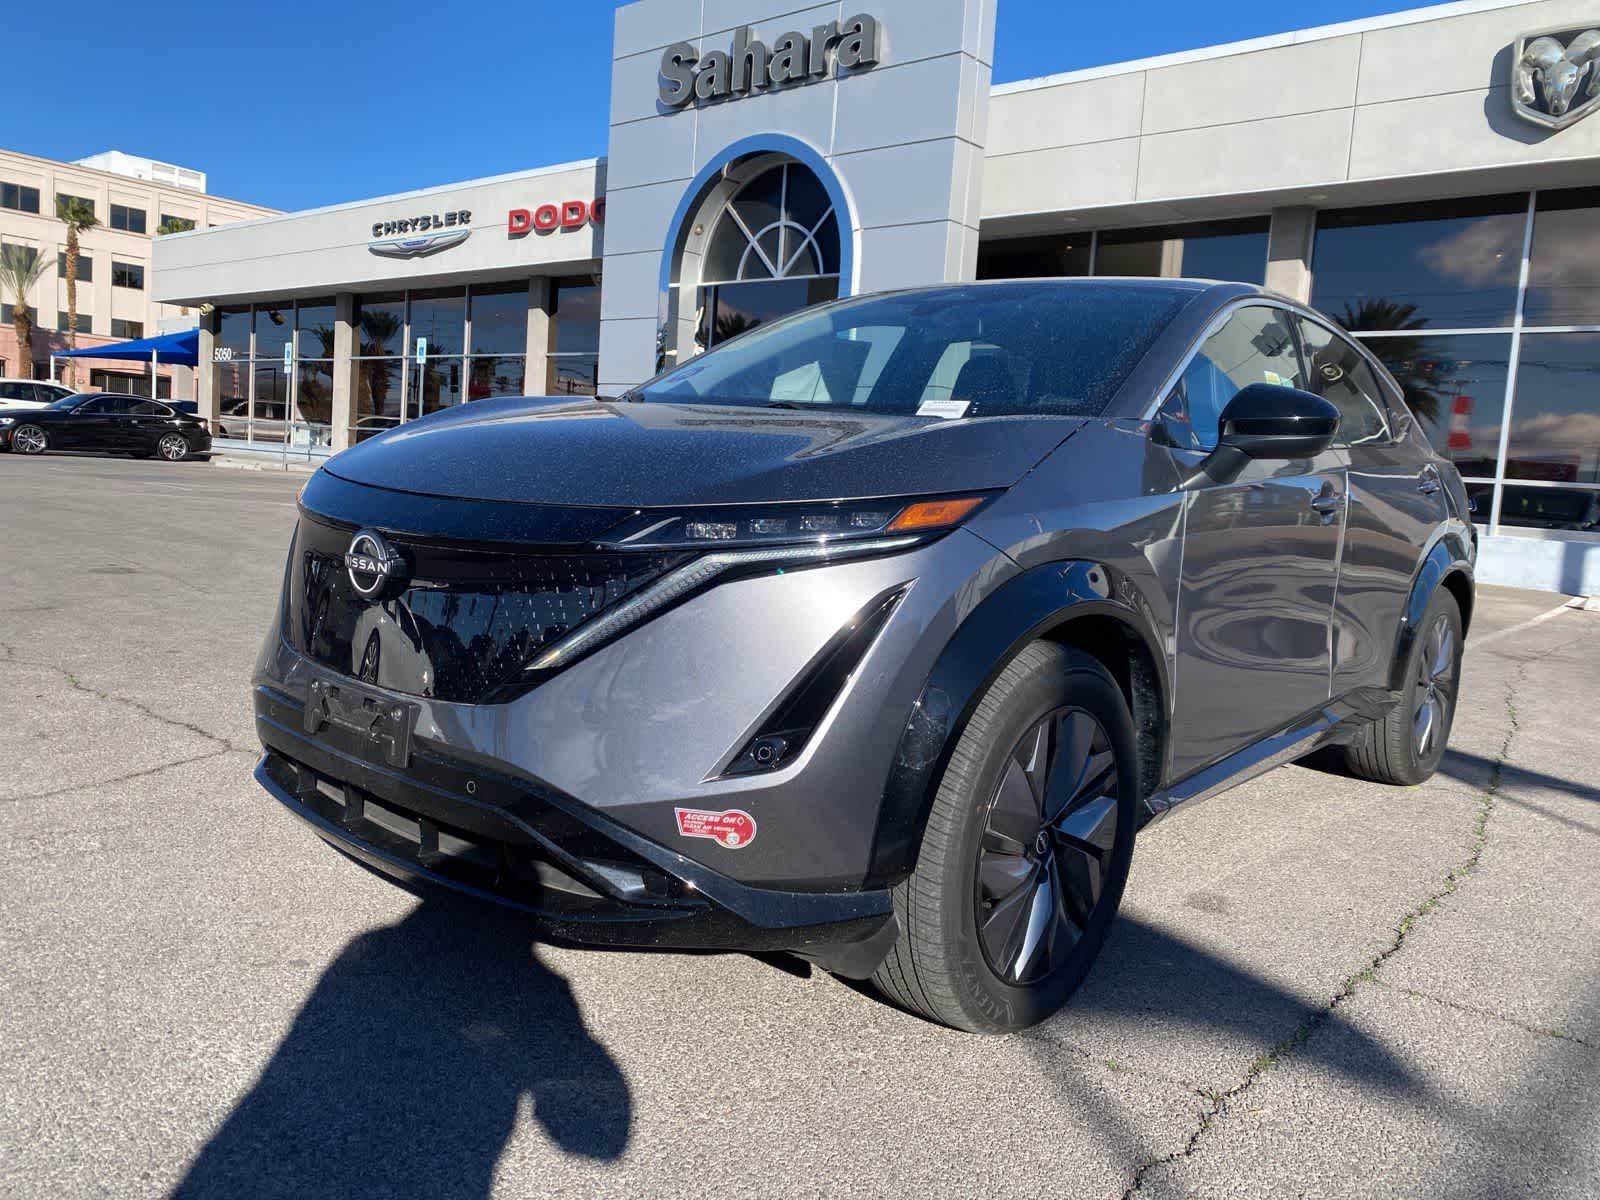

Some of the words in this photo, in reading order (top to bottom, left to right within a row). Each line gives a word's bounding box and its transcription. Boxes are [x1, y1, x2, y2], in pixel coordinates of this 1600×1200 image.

[658, 13, 881, 107] Sahara
[372, 210, 472, 237] CHRYSLER
[214, 347, 232, 361] 5050
[344, 552, 388, 574] NISSAN
